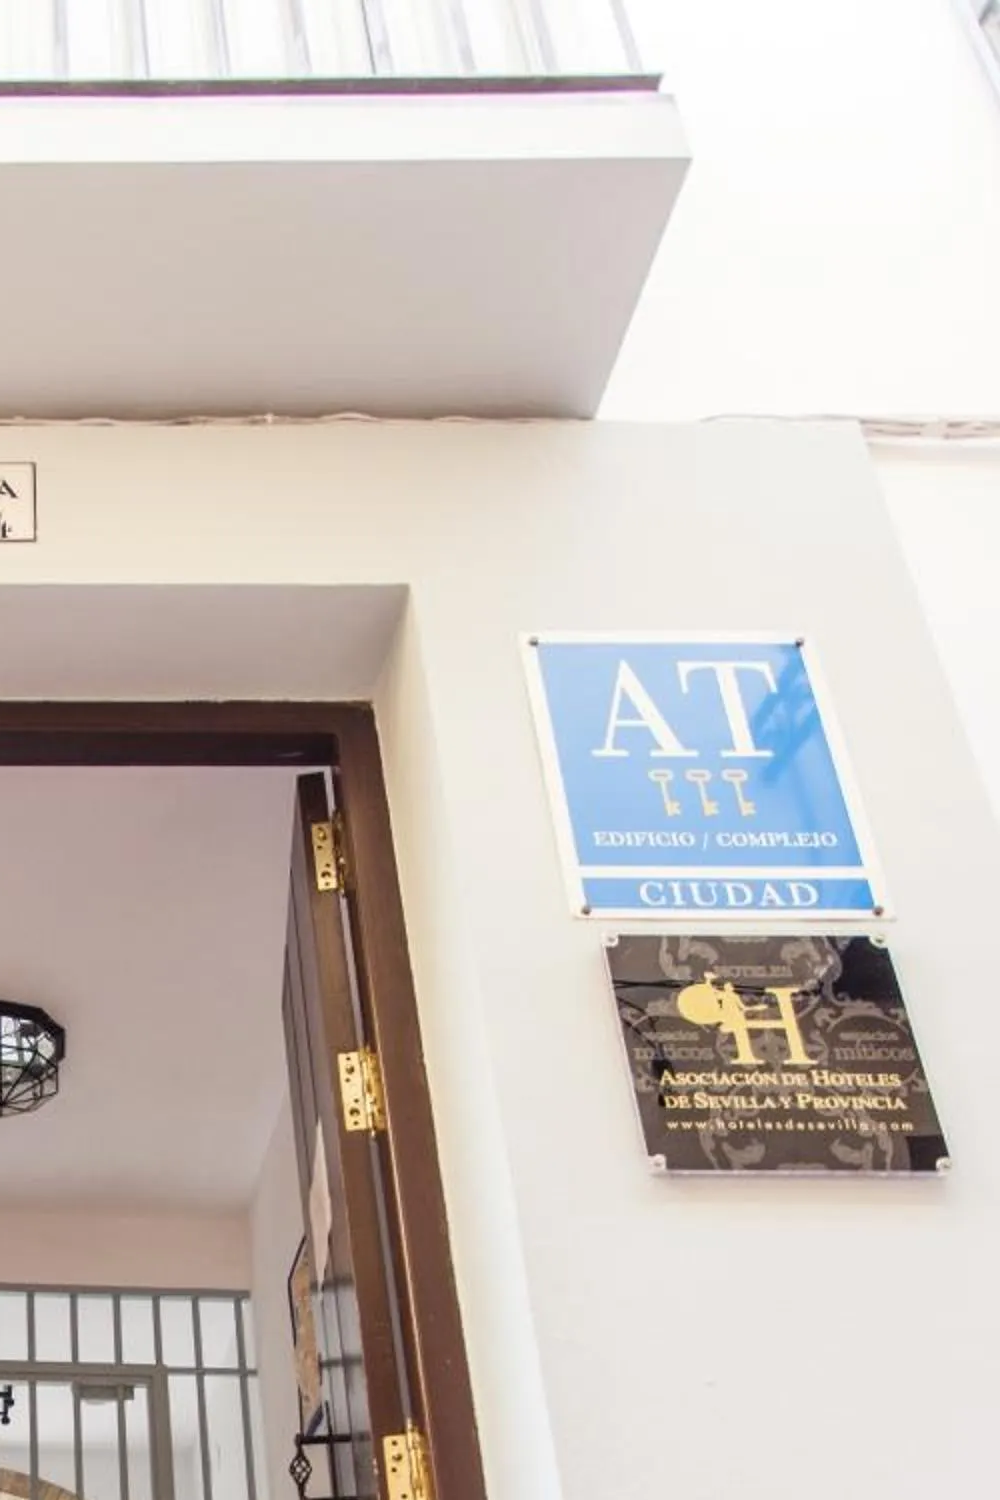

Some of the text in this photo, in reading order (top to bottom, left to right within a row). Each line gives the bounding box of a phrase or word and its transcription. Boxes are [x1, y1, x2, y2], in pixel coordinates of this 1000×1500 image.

[591, 660, 778, 757] AT
[593, 831, 696, 847] EDIFICIO
[716, 831, 838, 847] COMPLEJO
[638, 882, 819, 907] CIUDAD
[659, 1069, 901, 1087] ASOCIACIÓN DE HOTELES
[664, 1095, 691, 1109] DE
[694, 1092, 777, 1109] SEVILLA
[797, 1093, 908, 1110] PROVINCIA
